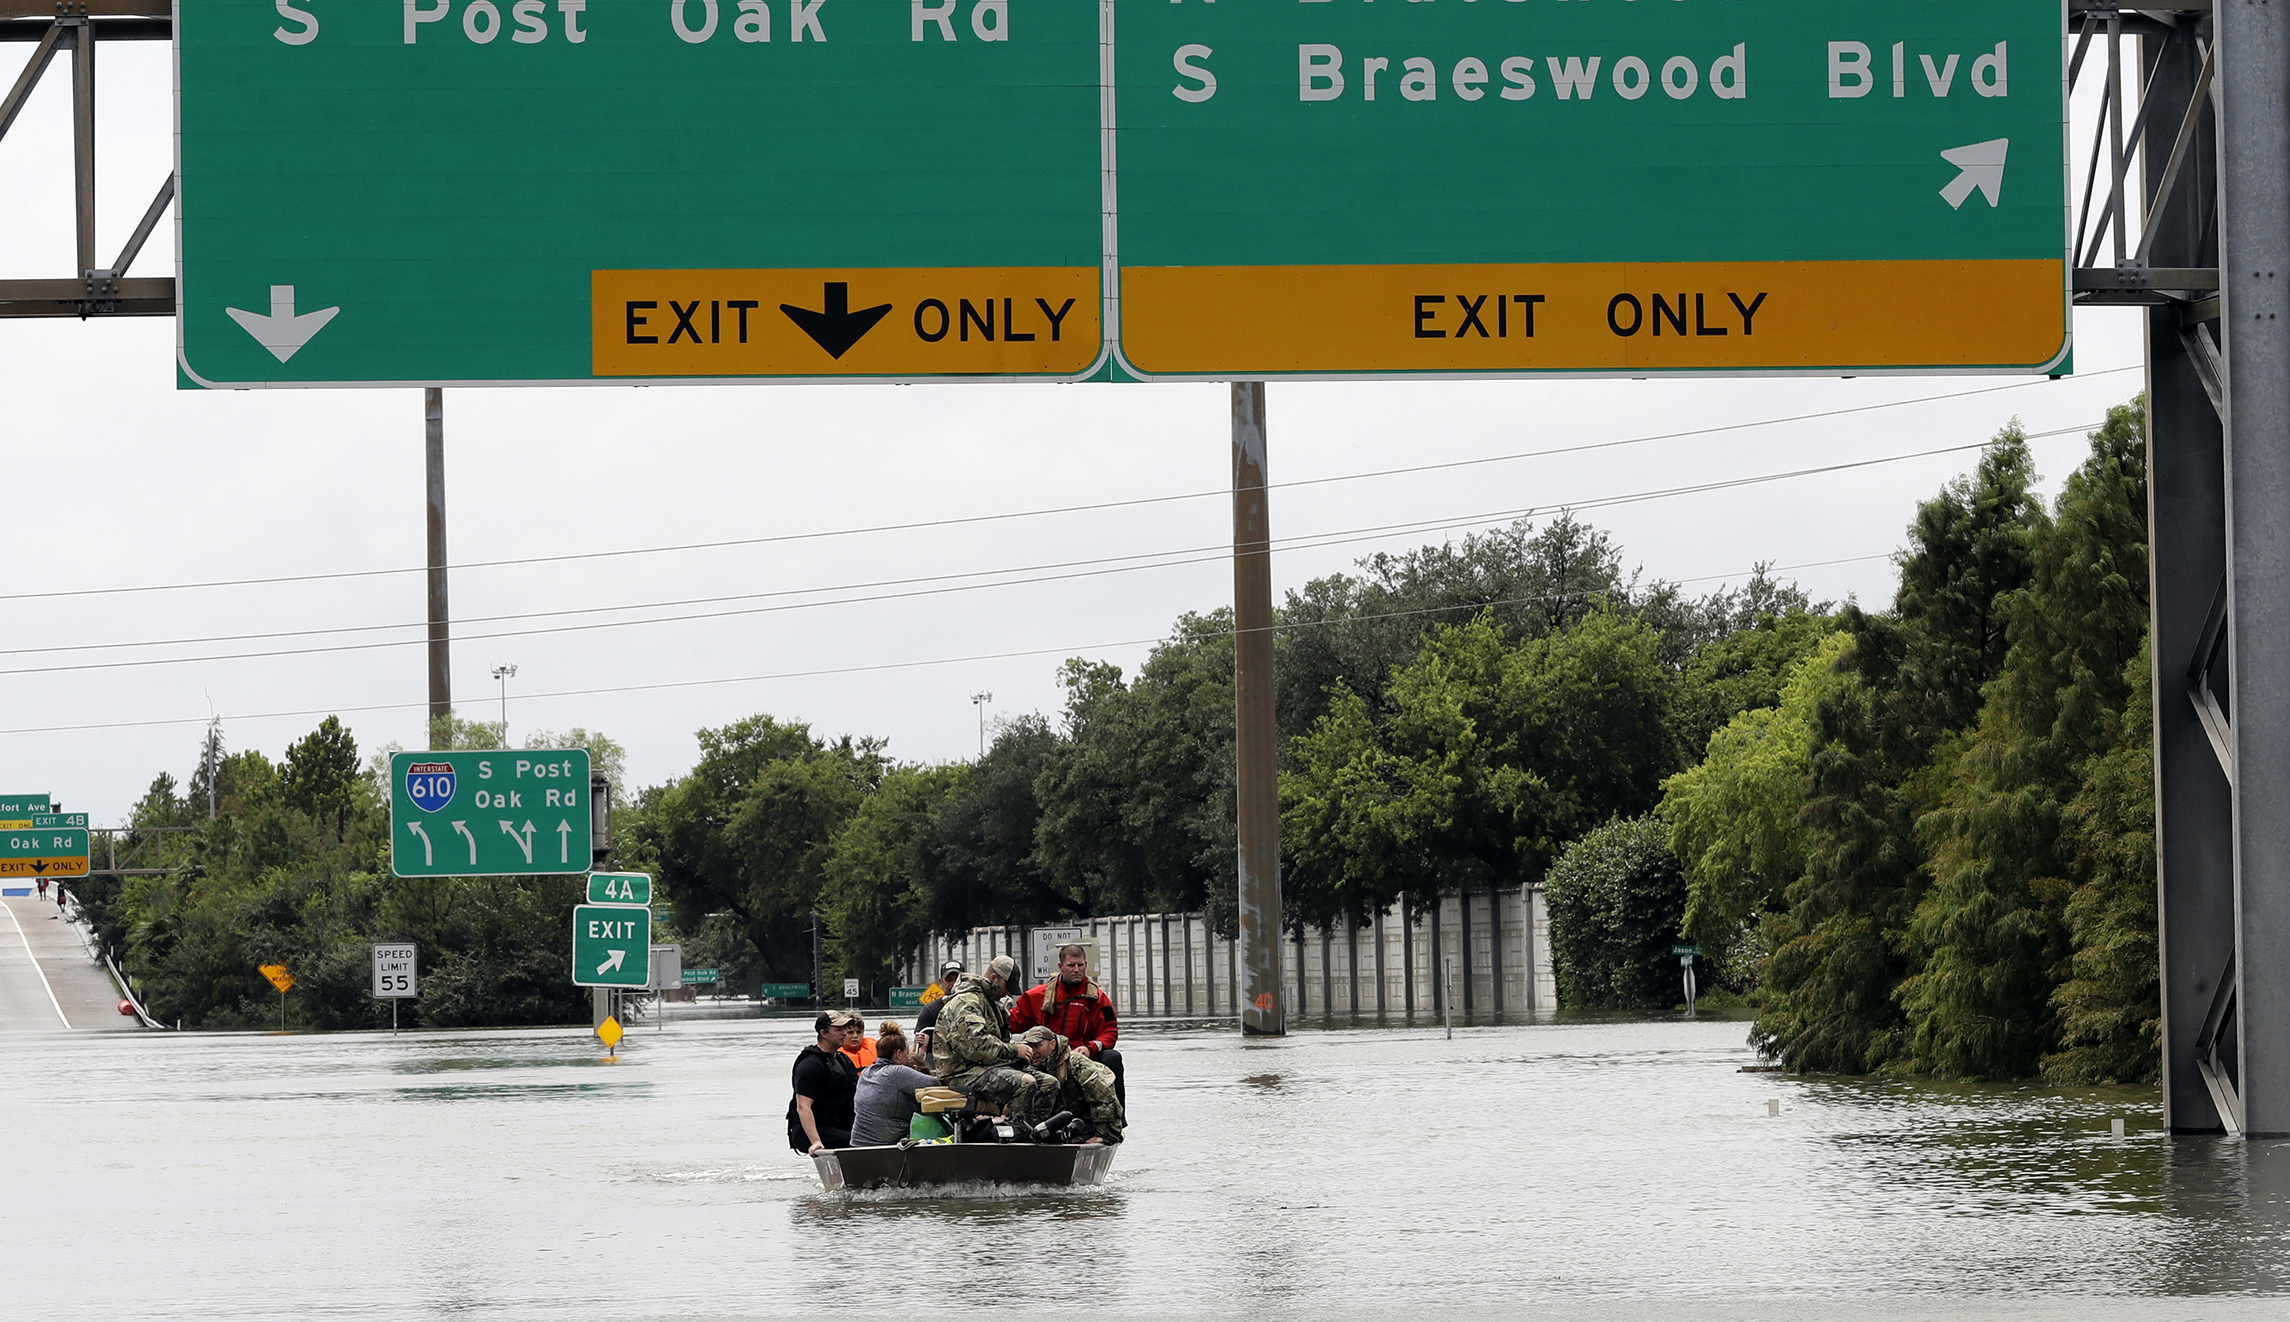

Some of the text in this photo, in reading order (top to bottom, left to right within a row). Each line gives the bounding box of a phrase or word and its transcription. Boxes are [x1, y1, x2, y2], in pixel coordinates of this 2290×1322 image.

[273, 0, 1008, 45] S Post Oak Rd
[1172, 41, 2007, 102] S Braeswood Blvd
[627, 298, 1075, 344] EXIT ONLY
[1415, 293, 1767, 338] EXIT ONLY
[478, 760, 572, 779] S Post
[413, 777, 450, 798] 610
[475, 789, 576, 808] Oak Rd
[36, 815, 85, 826] EXIT 4B
[10, 837, 72, 849] Oak Rd
[1, 862, 83, 872] EXIT ONLY
[604, 880, 634, 900] 4A
[588, 921, 636, 940] EXIT
[377, 950, 413, 959] SPEED
[381, 963, 408, 971] LIMIT
[381, 975, 409, 991] 55
[846, 988, 857, 996] 45
[1255, 993, 1274, 1010] 40
